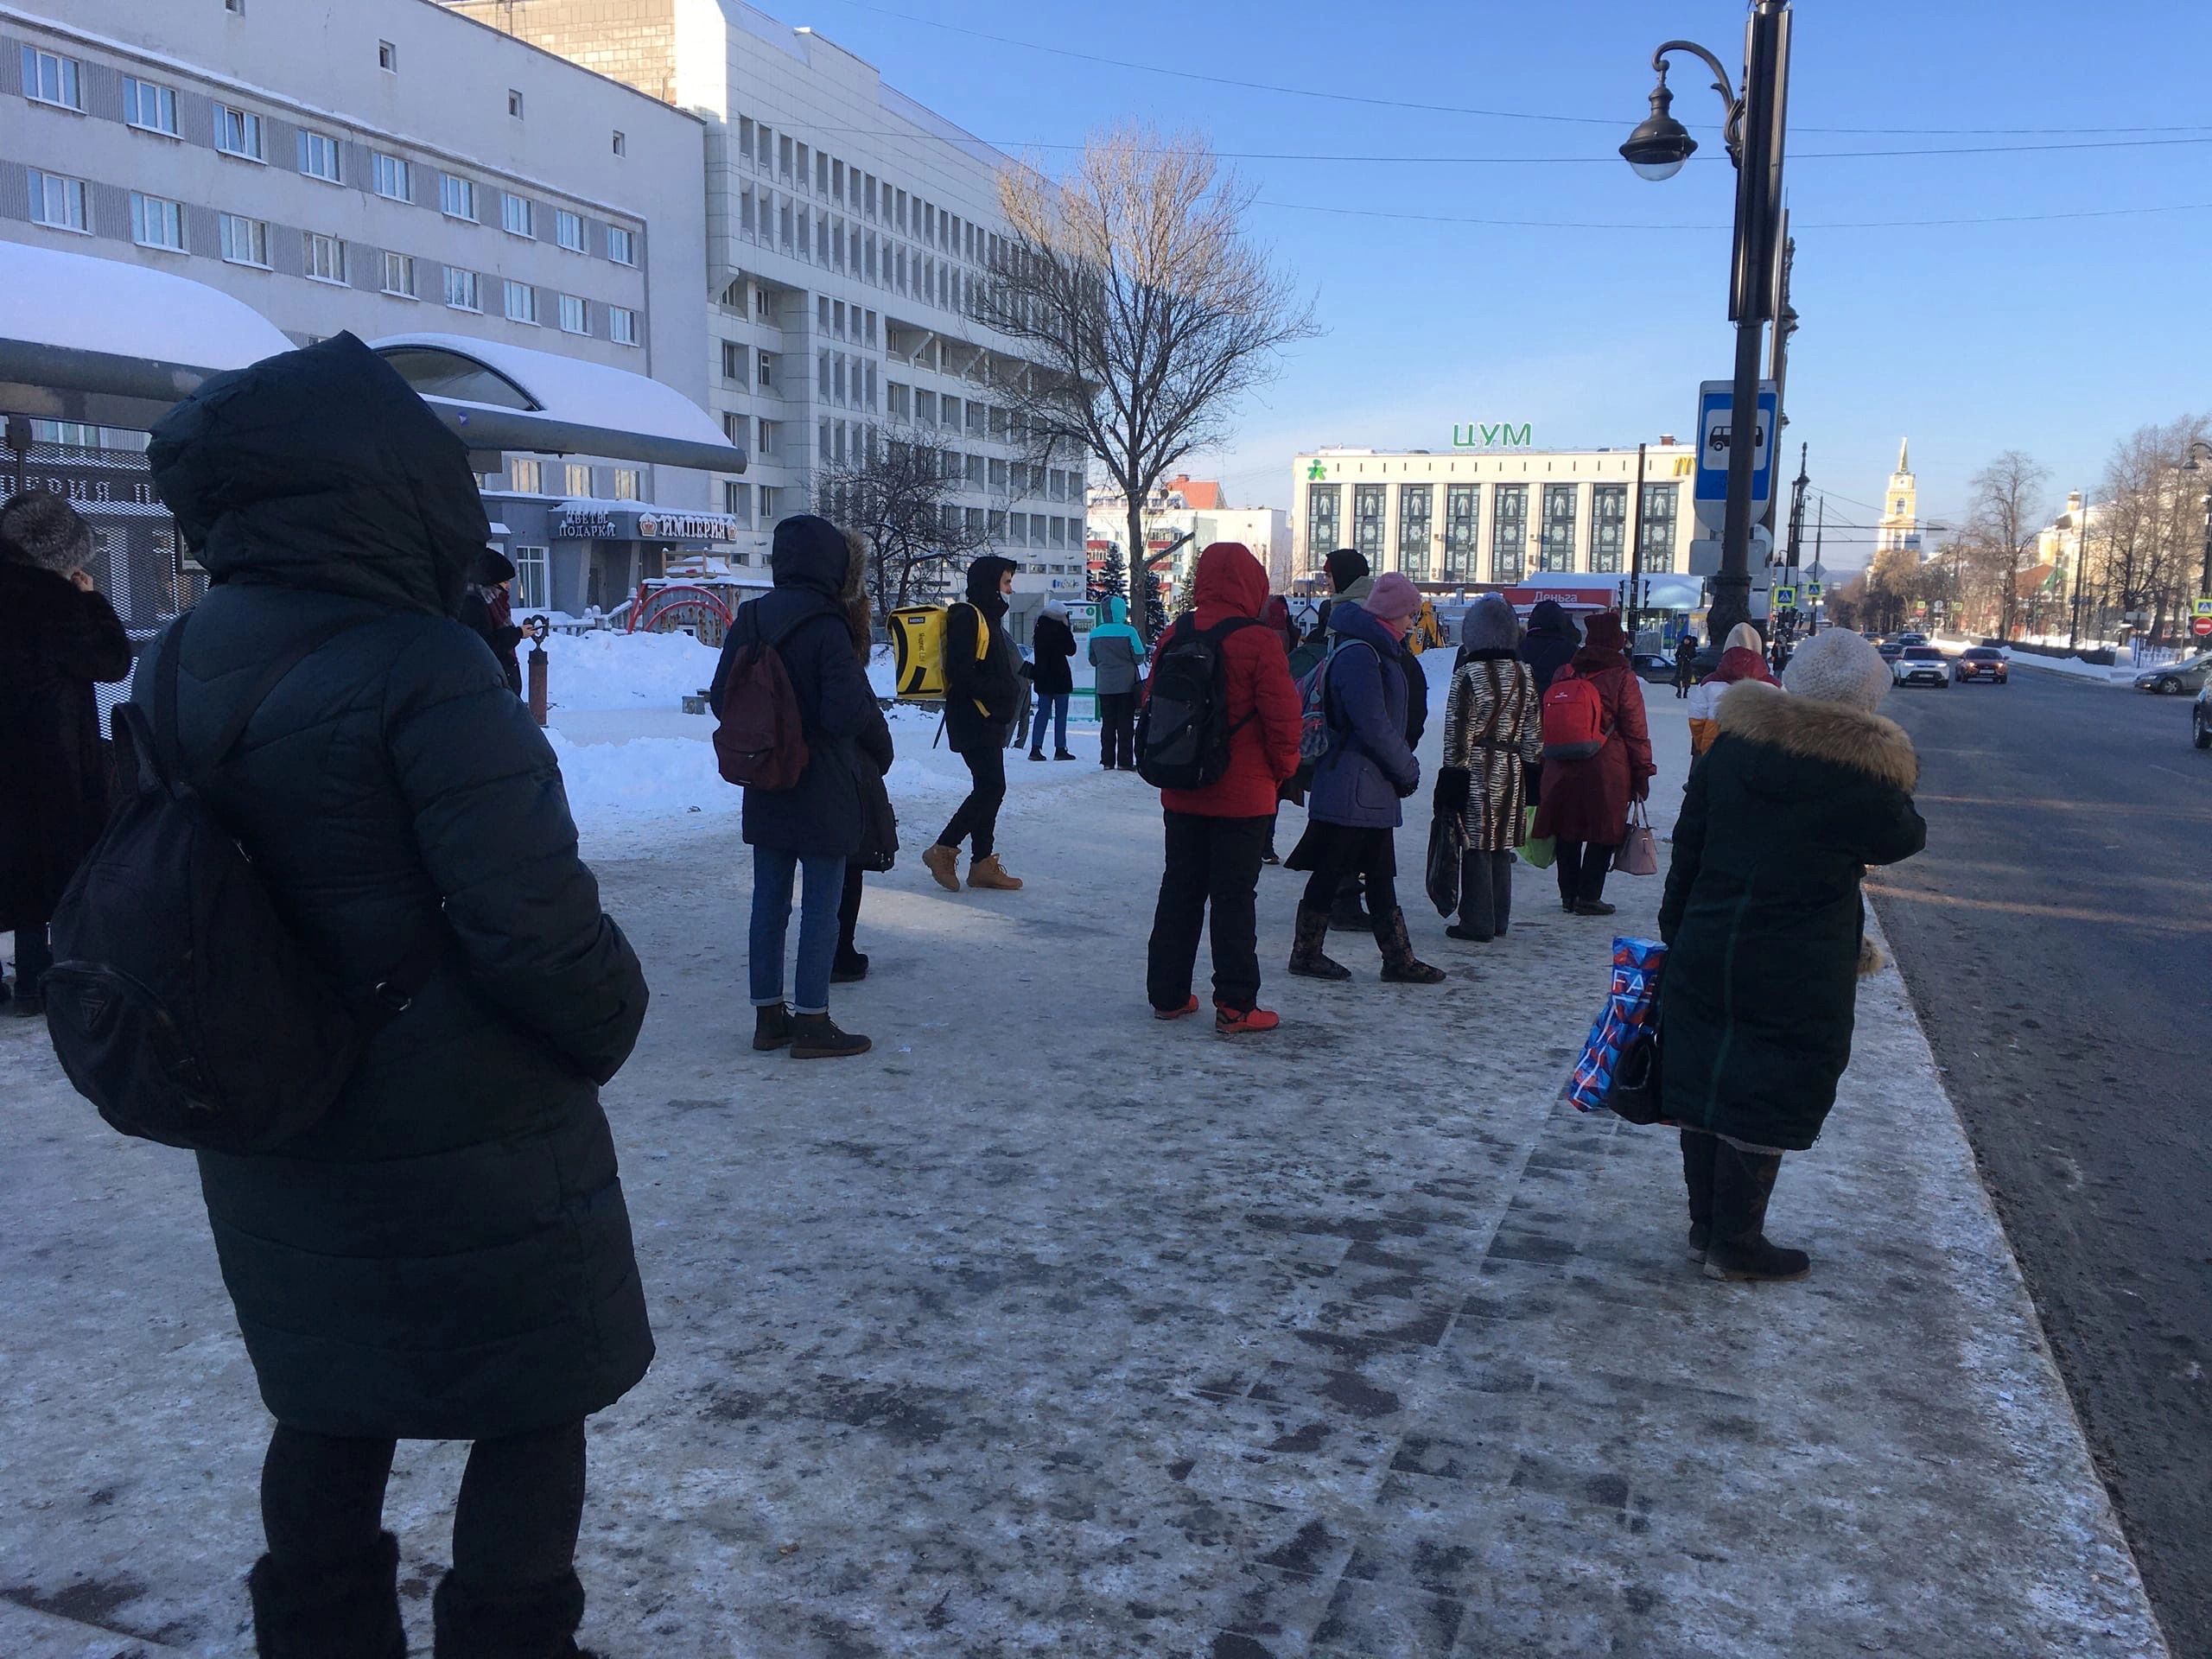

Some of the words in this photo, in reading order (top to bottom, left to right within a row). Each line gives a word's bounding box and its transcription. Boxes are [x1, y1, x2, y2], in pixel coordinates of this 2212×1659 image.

[1452, 421, 1533, 448] ЦУМ
[566, 510, 608, 524] ЦВЕТЫ
[559, 523, 616, 538] ПОДАРКИ
[660, 516, 726, 540] ИМПЕРИЯ
[1533, 591, 1578, 603] Деньга
